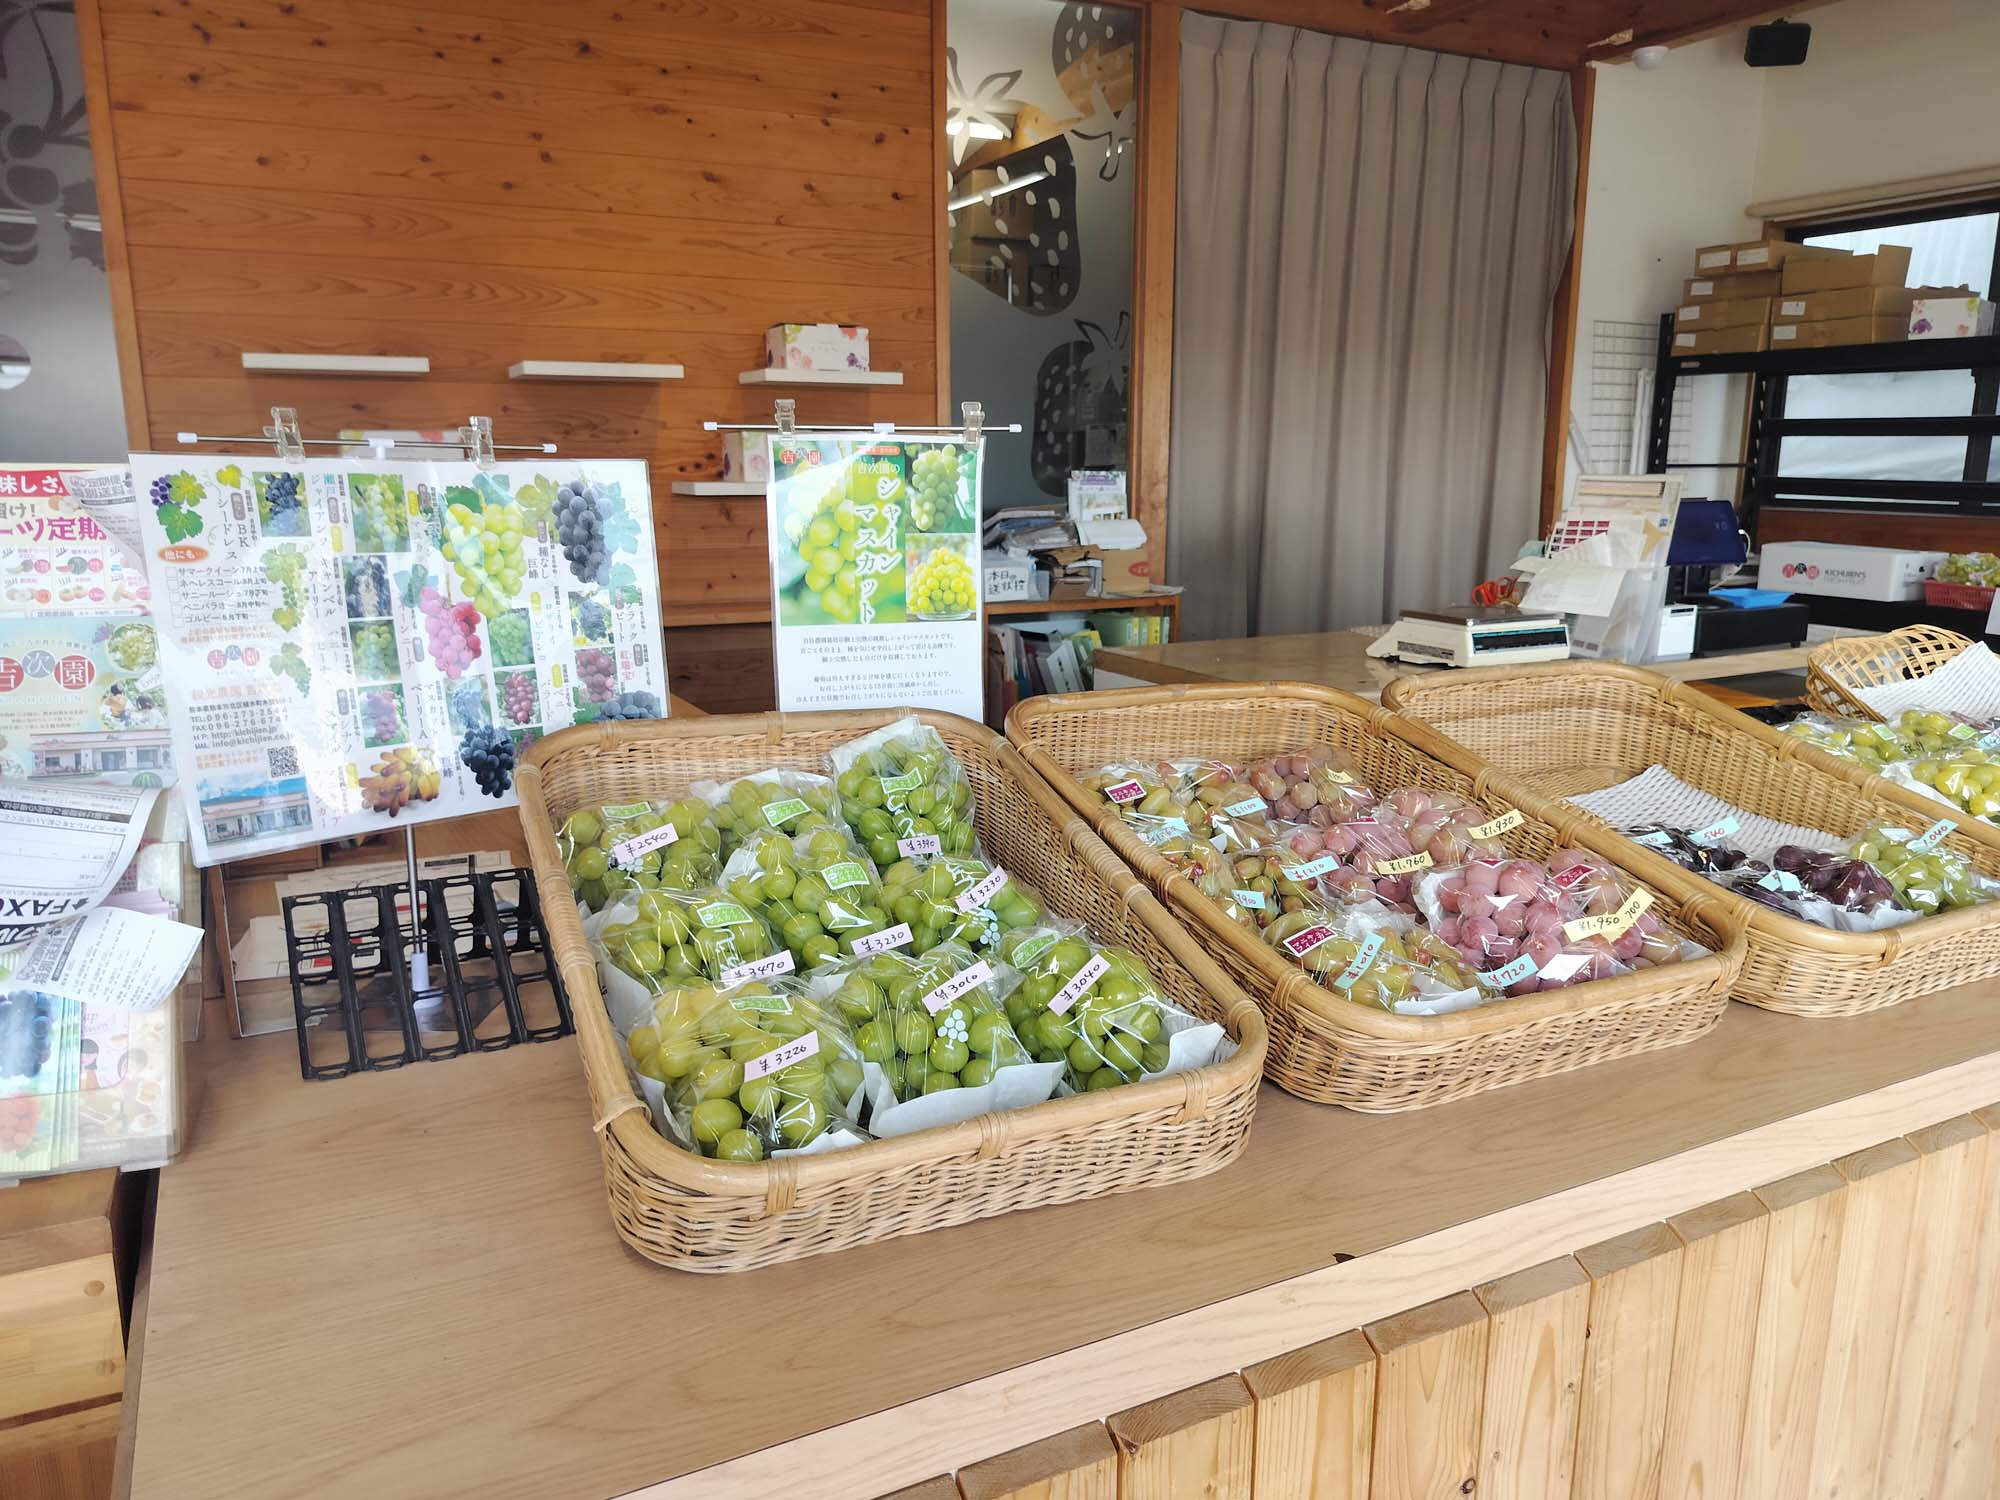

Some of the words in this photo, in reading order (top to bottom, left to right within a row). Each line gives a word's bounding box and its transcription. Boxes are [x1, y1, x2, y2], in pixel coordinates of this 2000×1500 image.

[877, 478, 901, 572] シャイン
[855, 505, 877, 622] マスカット
[624, 831, 669, 858] ¥2540
[967, 874, 1001, 905] ¥3230
[861, 930, 905, 951] ¥3230
[1060, 963, 1100, 1001] ¥3040
[1488, 961, 1526, 986] ¥720
